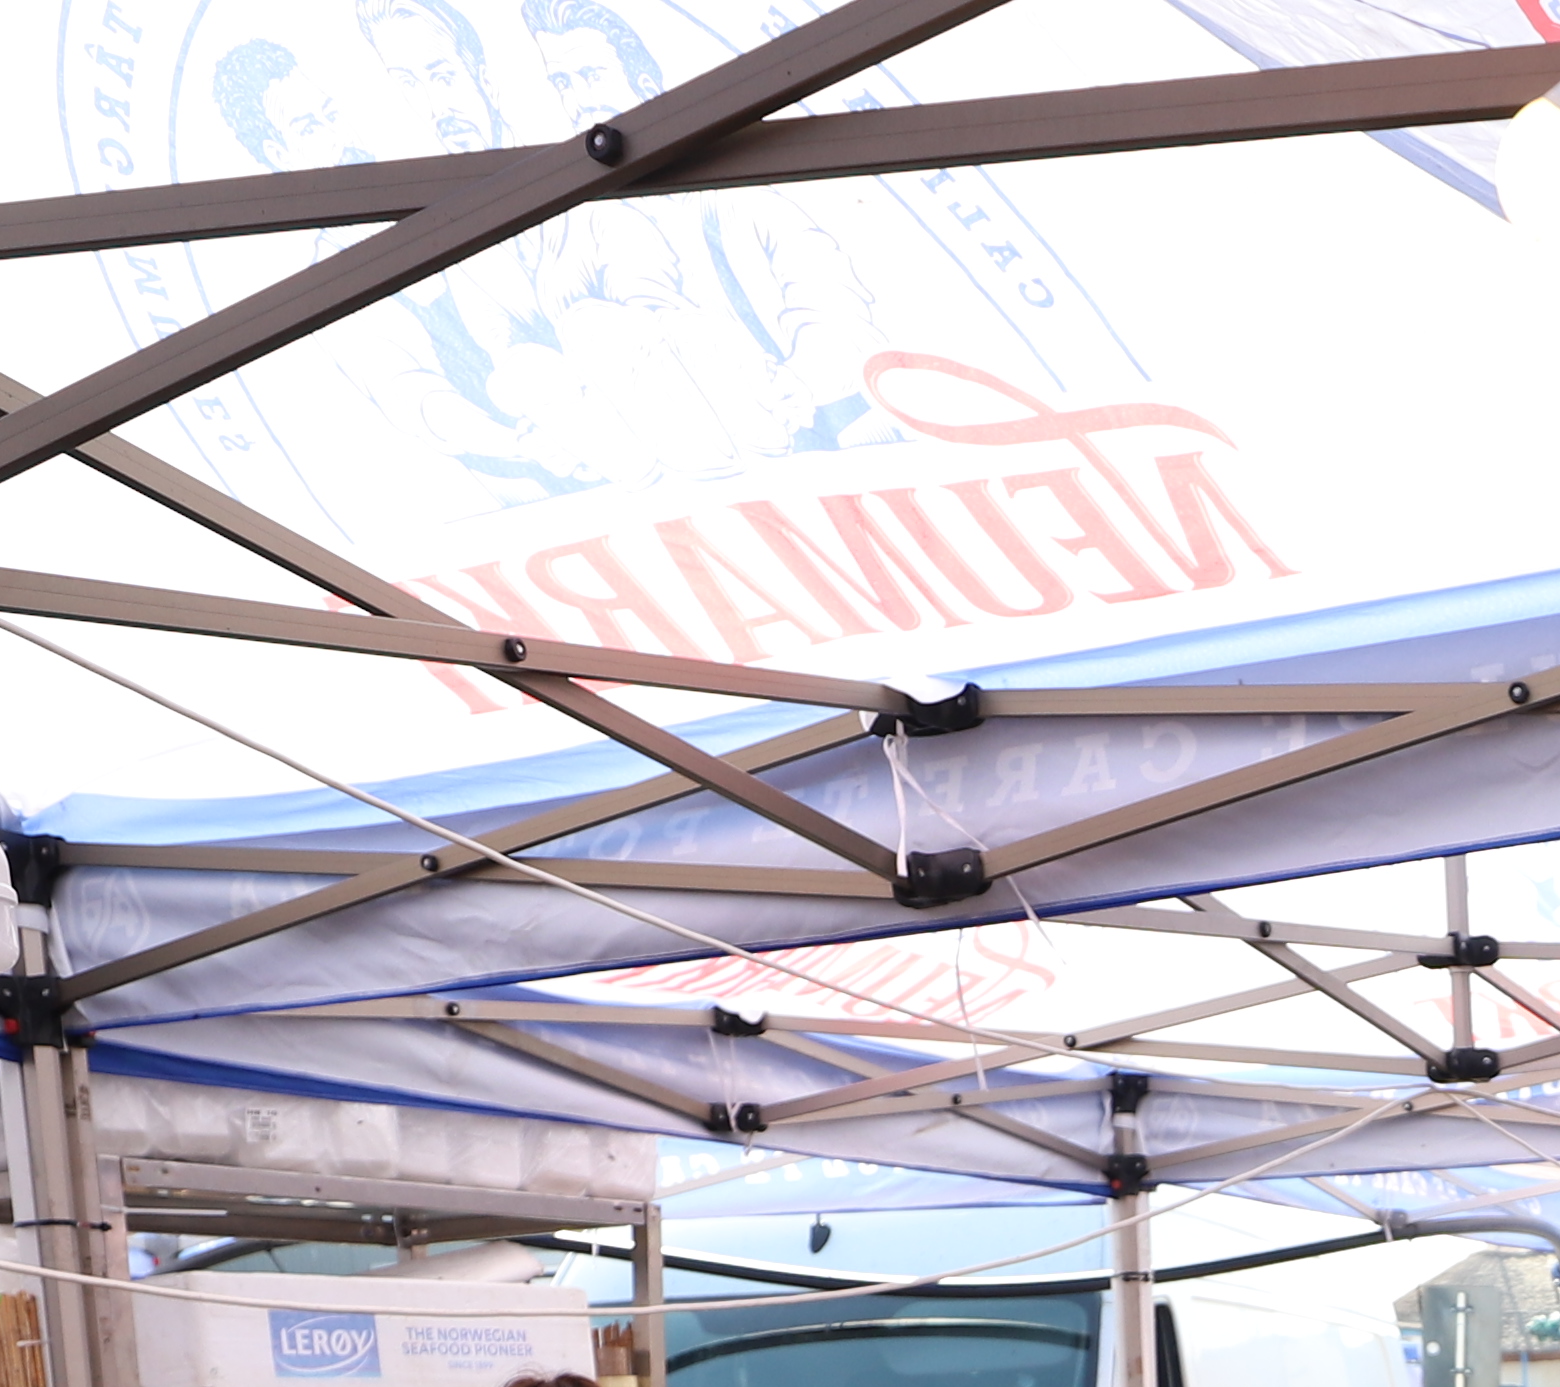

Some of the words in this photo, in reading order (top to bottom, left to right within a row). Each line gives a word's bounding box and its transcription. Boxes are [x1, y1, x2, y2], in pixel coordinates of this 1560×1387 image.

[281, 1327, 371, 1356] LERØY
[406, 1327, 434, 1340] THE
[438, 1328, 527, 1343] NORWEGIAN
[402, 1341, 471, 1356] SEAFOOD
[474, 1344, 534, 1357] PIONEER
